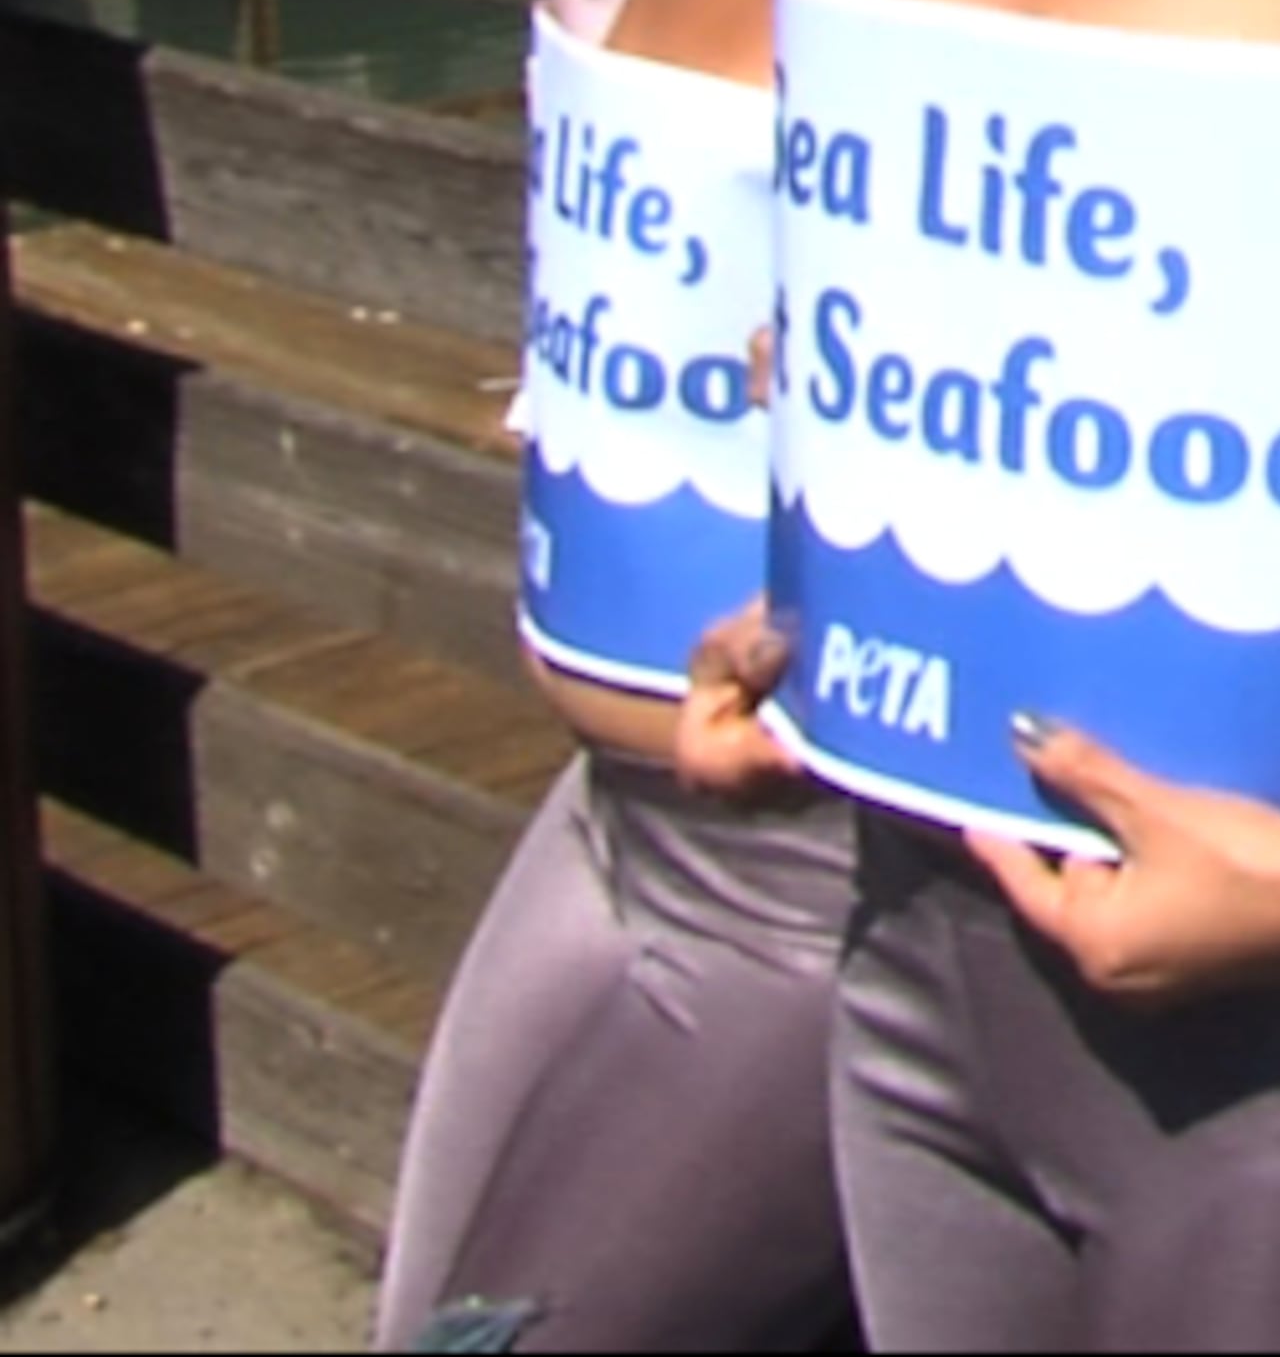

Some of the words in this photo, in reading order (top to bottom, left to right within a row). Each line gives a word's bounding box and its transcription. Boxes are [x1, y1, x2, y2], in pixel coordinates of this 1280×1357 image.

[554, 113, 708, 288] Life,
[917, 103, 1190, 316] Life,
[530, 291, 753, 426] eafoo
